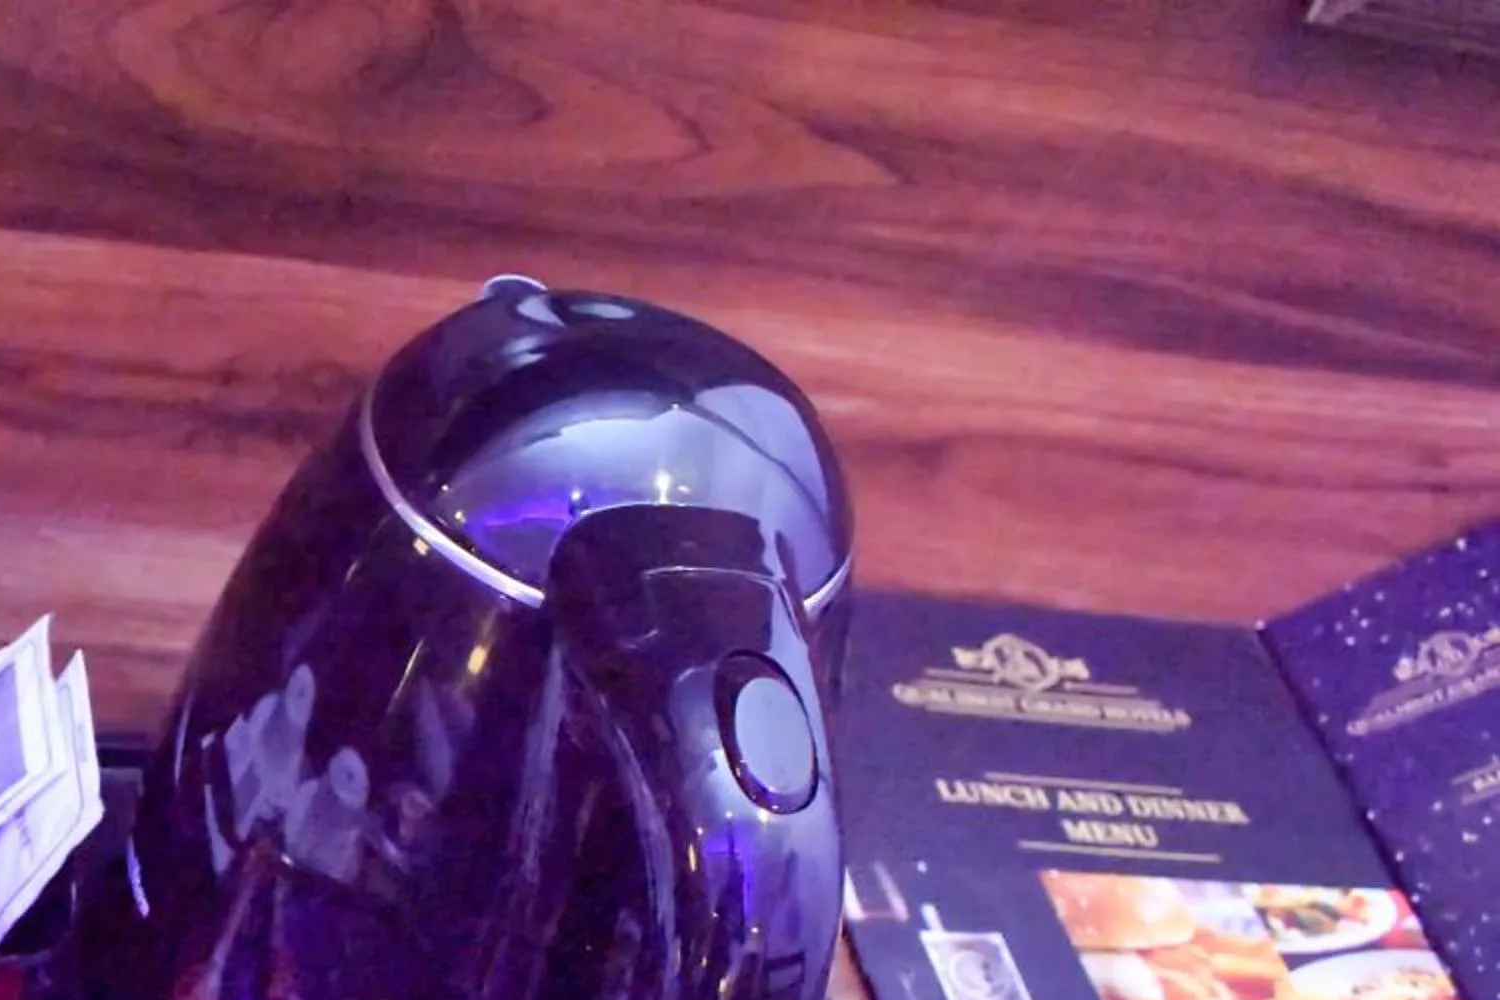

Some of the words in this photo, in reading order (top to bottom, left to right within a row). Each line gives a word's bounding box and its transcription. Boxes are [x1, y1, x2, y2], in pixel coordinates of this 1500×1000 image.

[935, 778, 1051, 811] LUNCH
[1057, 789, 1125, 817] AND
[1126, 794, 1250, 825] DINNER
[1060, 818, 1159, 848] MENU
